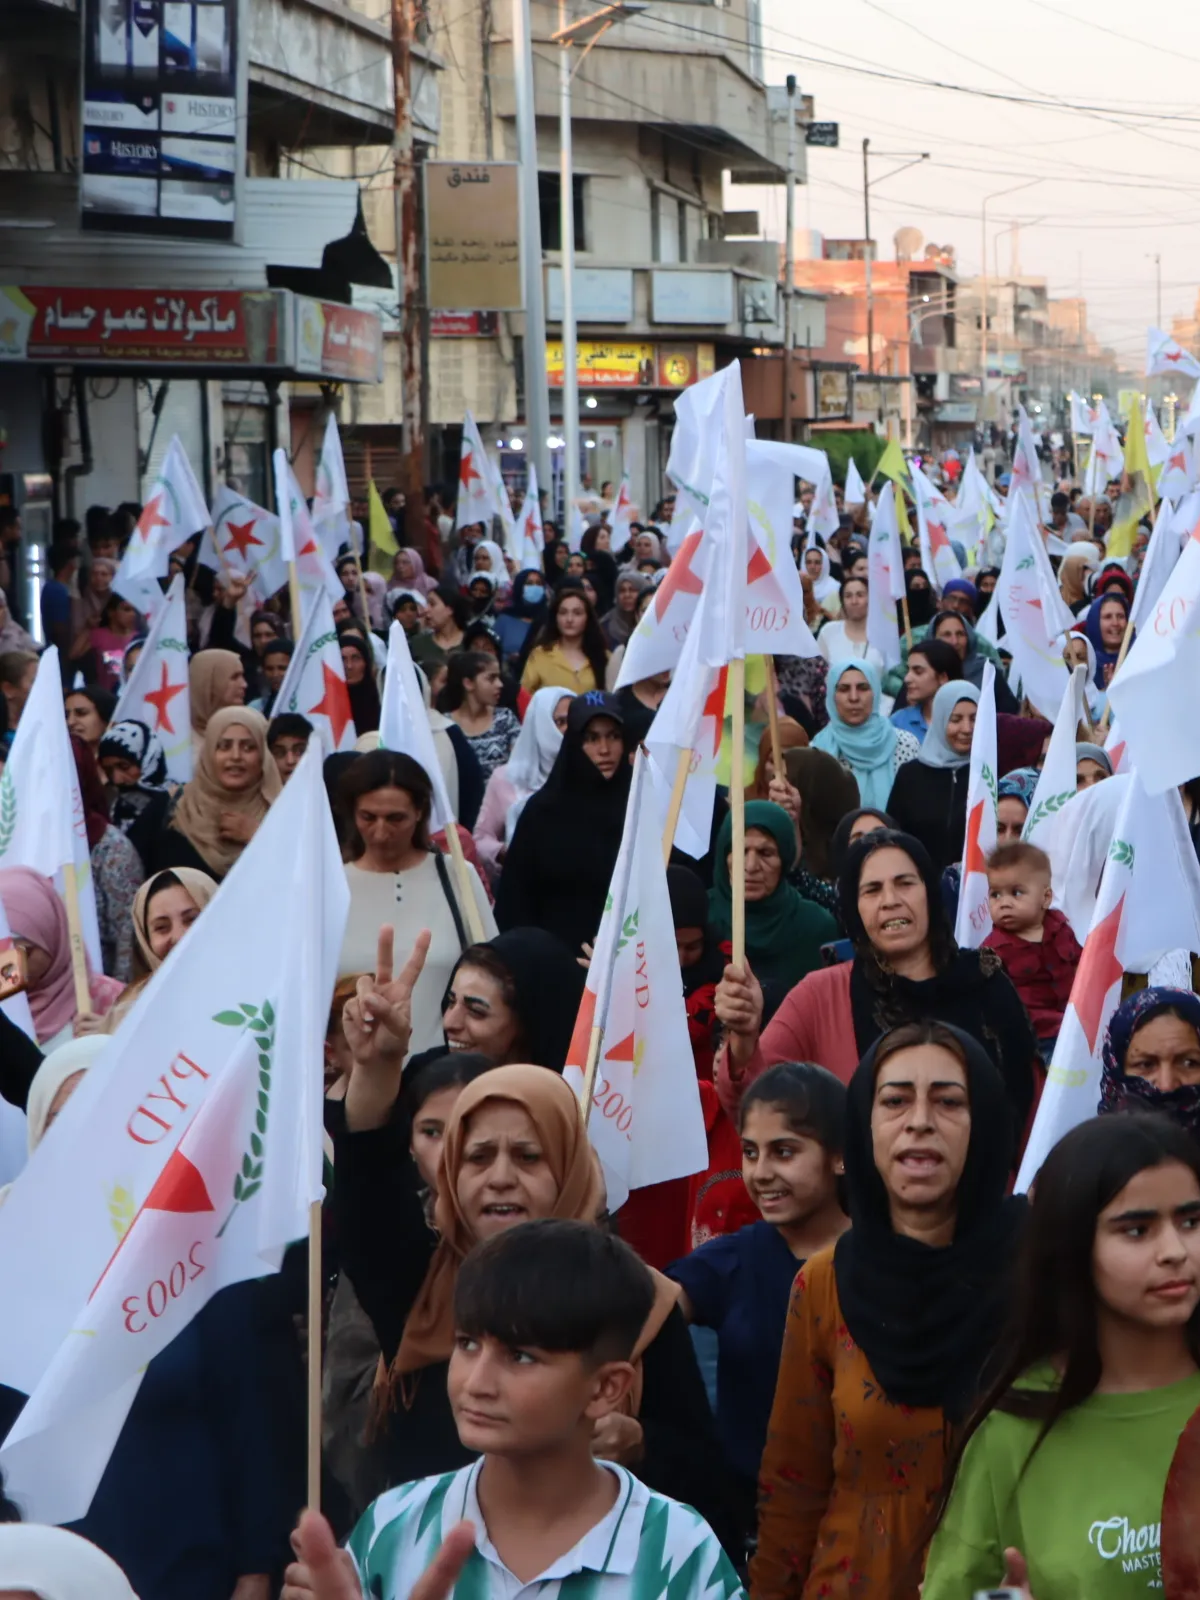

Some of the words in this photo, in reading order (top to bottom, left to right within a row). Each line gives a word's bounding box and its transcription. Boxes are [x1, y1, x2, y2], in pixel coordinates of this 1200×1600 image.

[188, 100, 234, 118] HISTORY
[111, 141, 157, 159] HISTORY
[447, 168, 490, 188] فندق
[45, 297, 96, 336] حسام
[101, 306, 147, 338] عمو
[152, 297, 236, 341] مأكولات
[592, 1079, 633, 1142] 200
